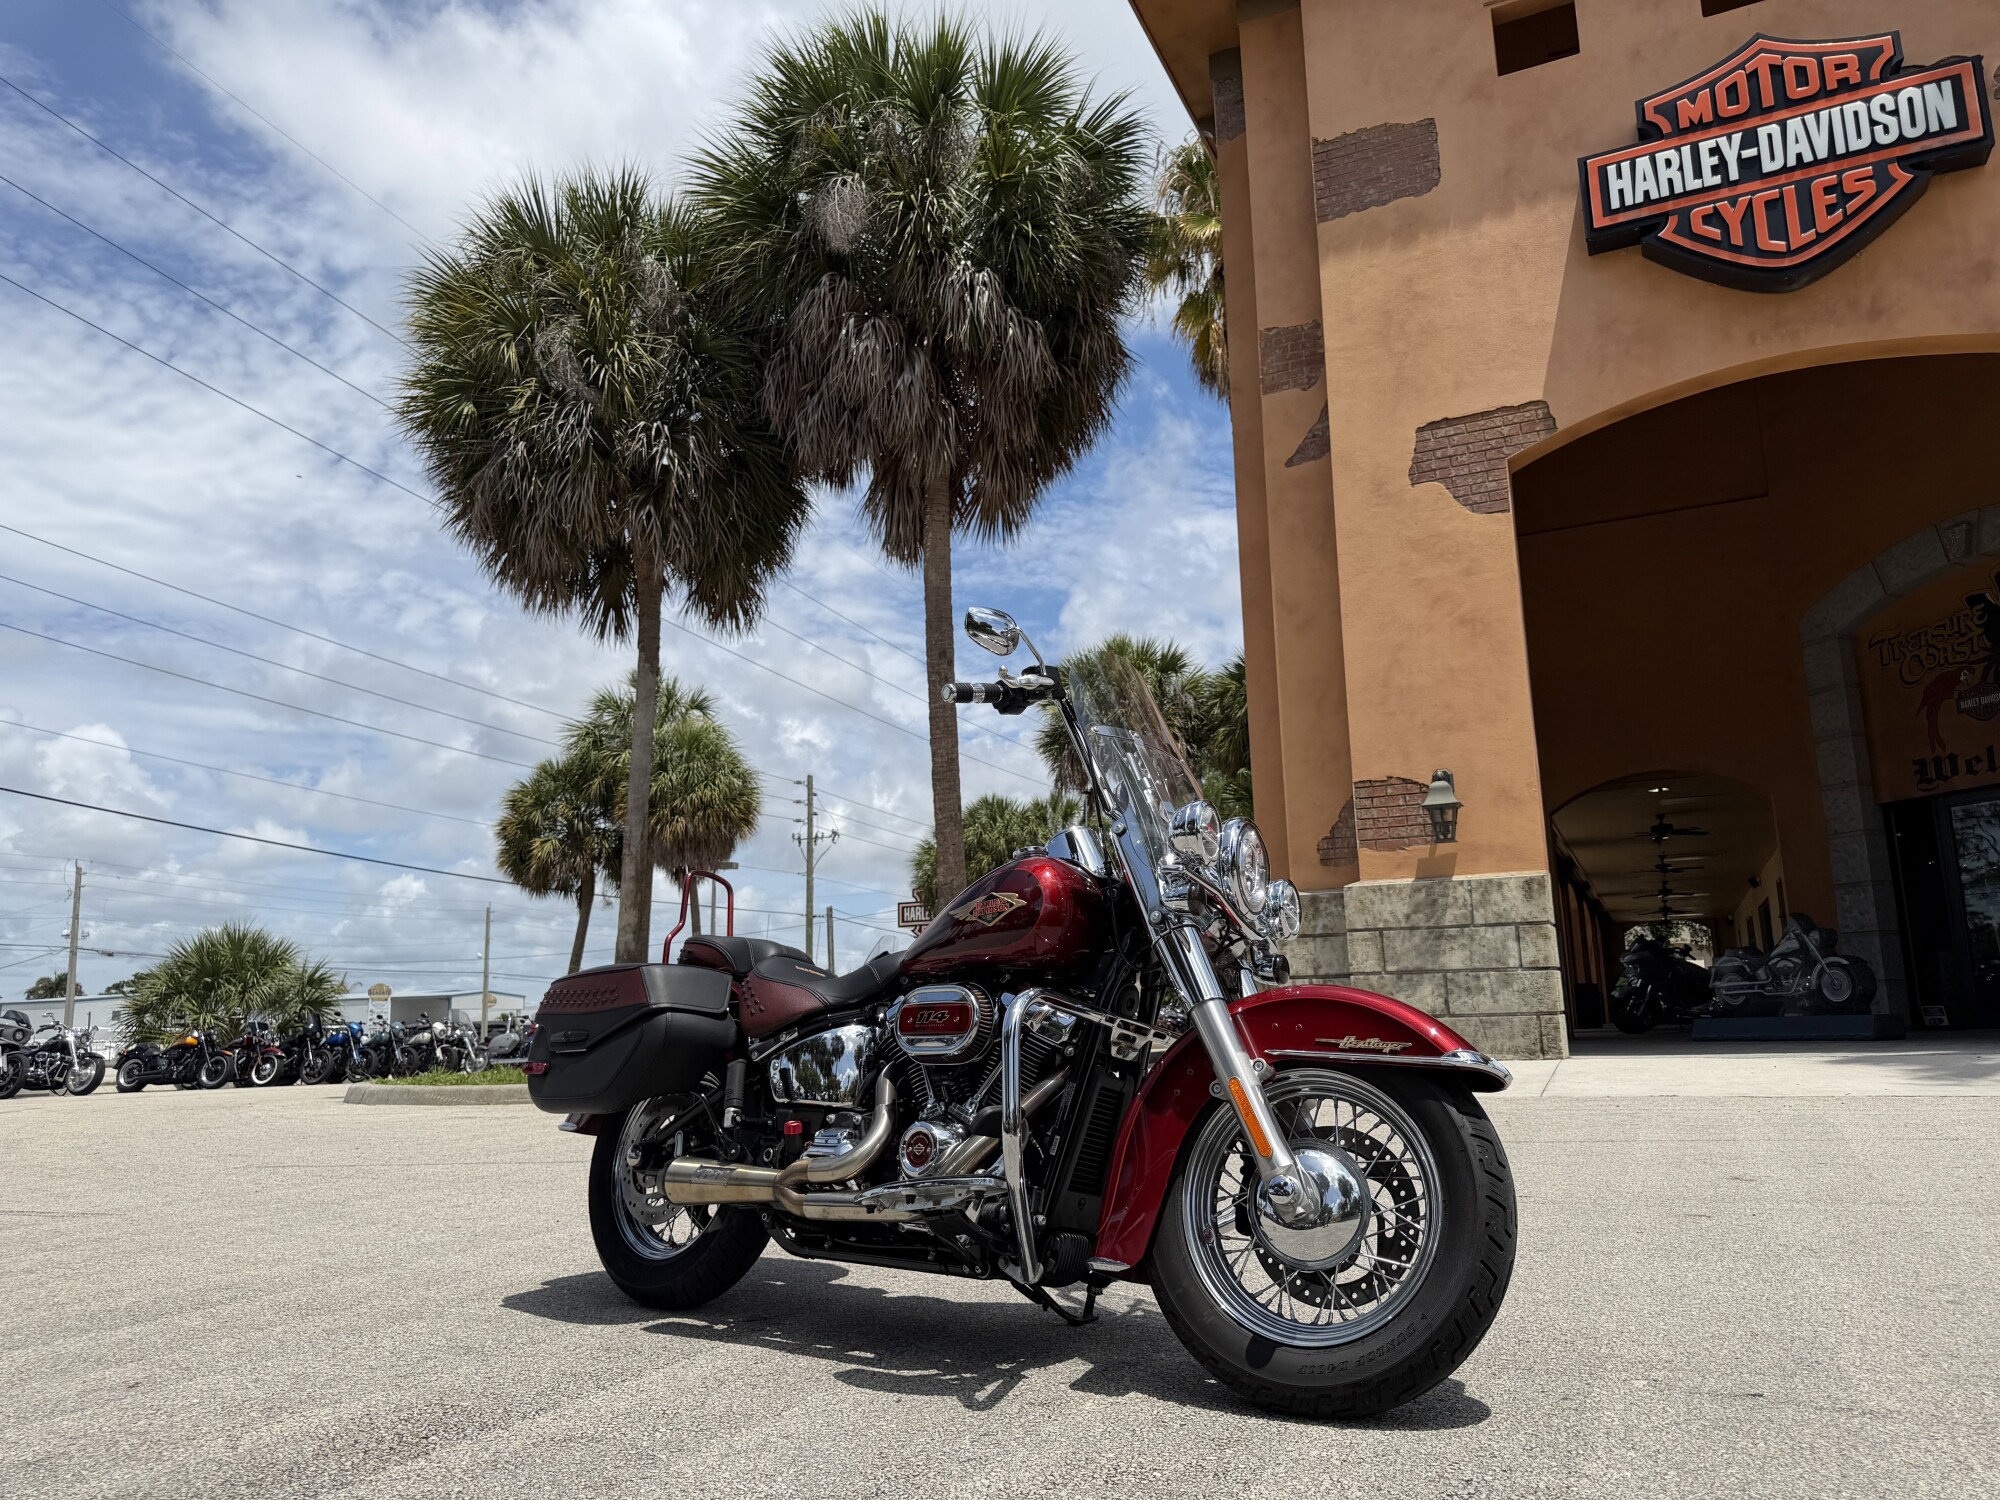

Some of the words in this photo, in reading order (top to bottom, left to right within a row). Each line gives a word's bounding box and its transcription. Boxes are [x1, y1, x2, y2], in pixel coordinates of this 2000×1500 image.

[1676, 53, 1862, 129] MOTOR
[1606, 79, 1959, 210] HARLEY-DAVIDSON
[1690, 166, 1878, 253] CYCLES
[1900, 627, 1990, 687] COAST
[973, 904, 1009, 918] DAVIDSON
[915, 1010, 950, 1024] 114
[1355, 1323, 1416, 1367] DUNLOP
